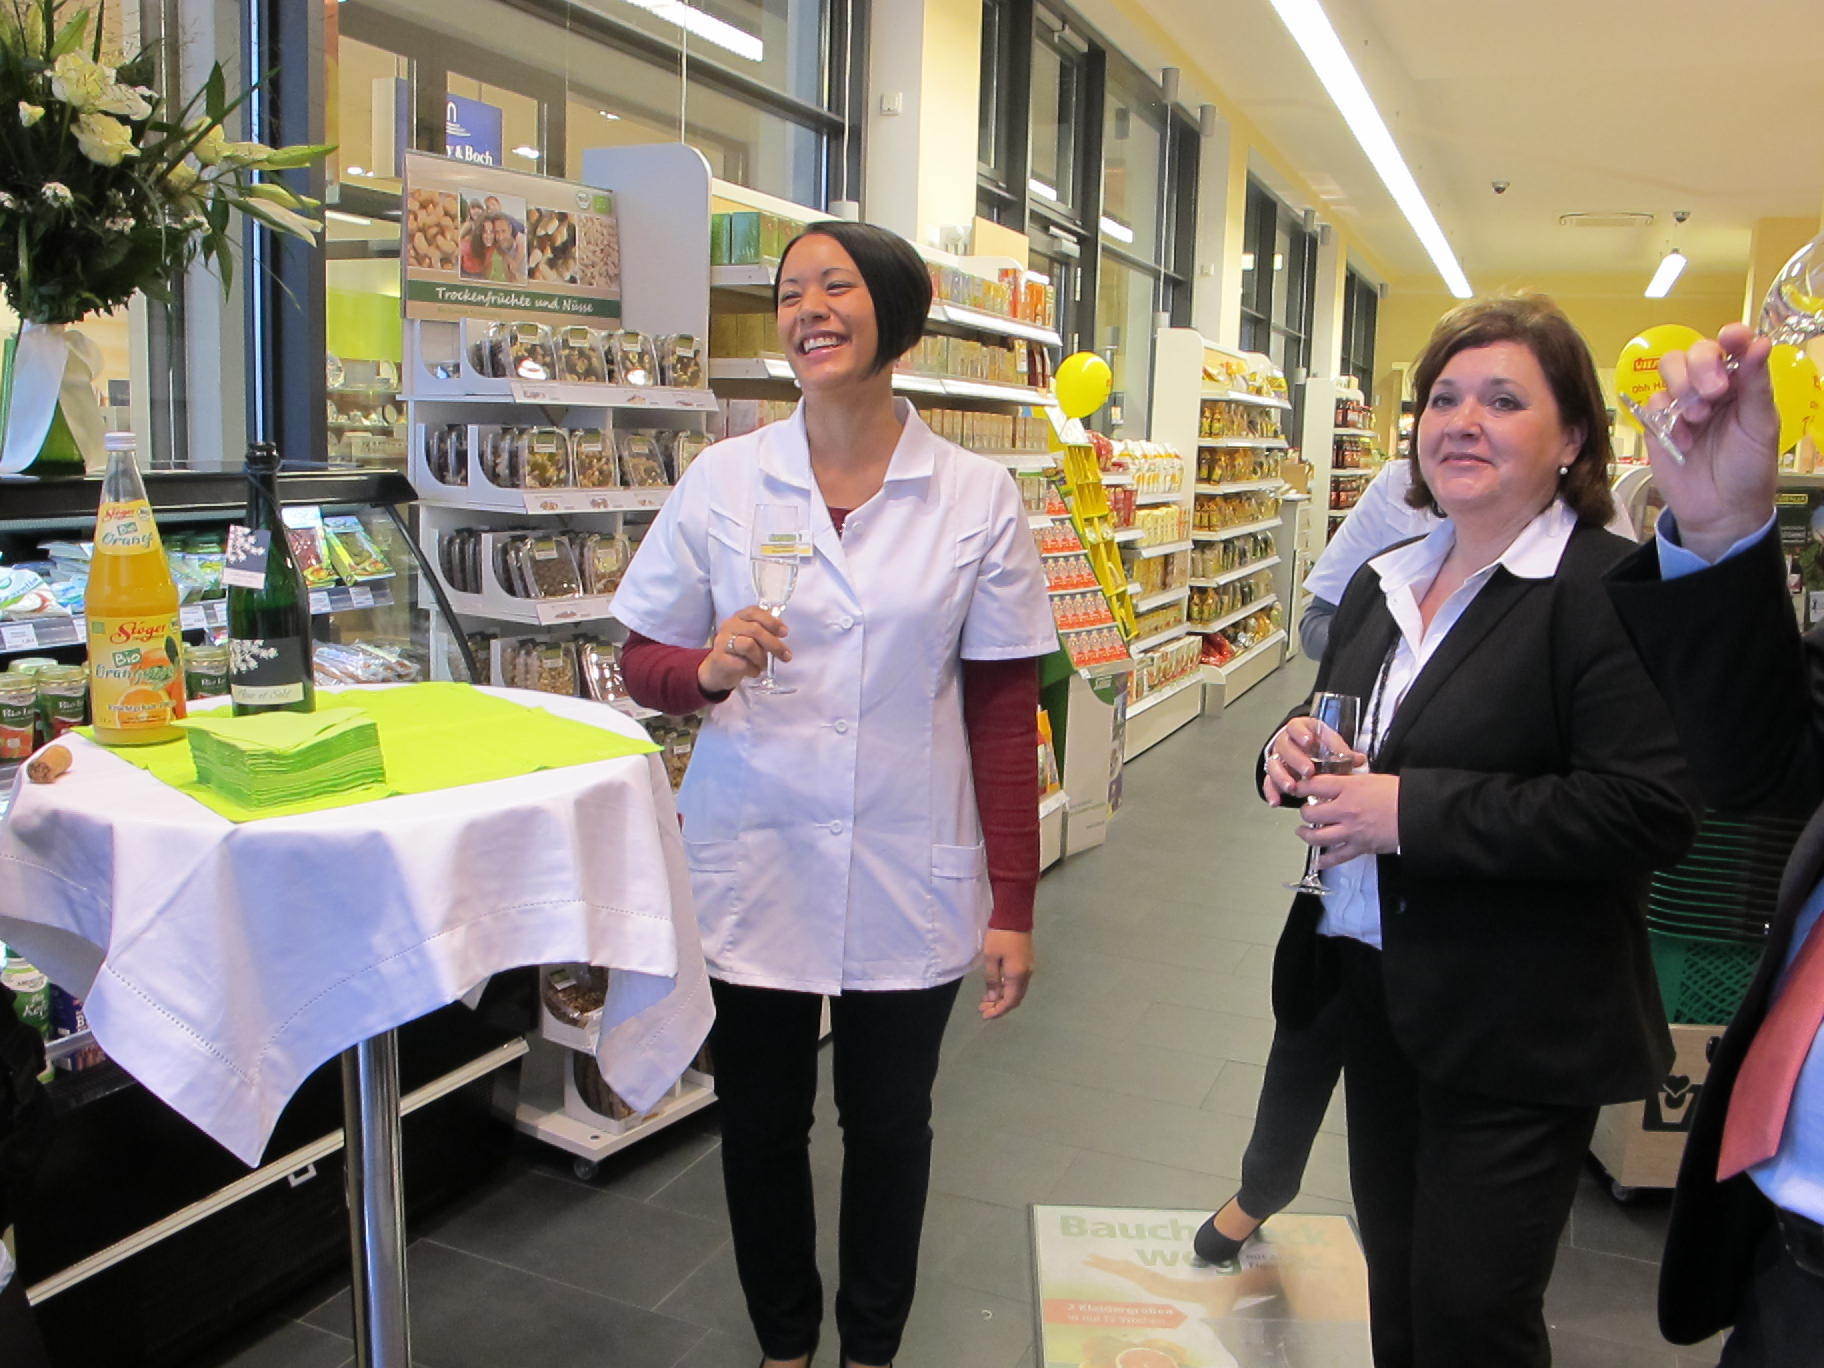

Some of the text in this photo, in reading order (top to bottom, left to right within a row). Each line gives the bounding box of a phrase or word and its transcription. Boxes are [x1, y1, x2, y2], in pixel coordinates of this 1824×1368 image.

[455, 145, 464, 159] &
[465, 145, 494, 167] Boch
[435, 286, 594, 314] Trockenfrüchte und Nüsse
[114, 649, 141, 666] Bio
